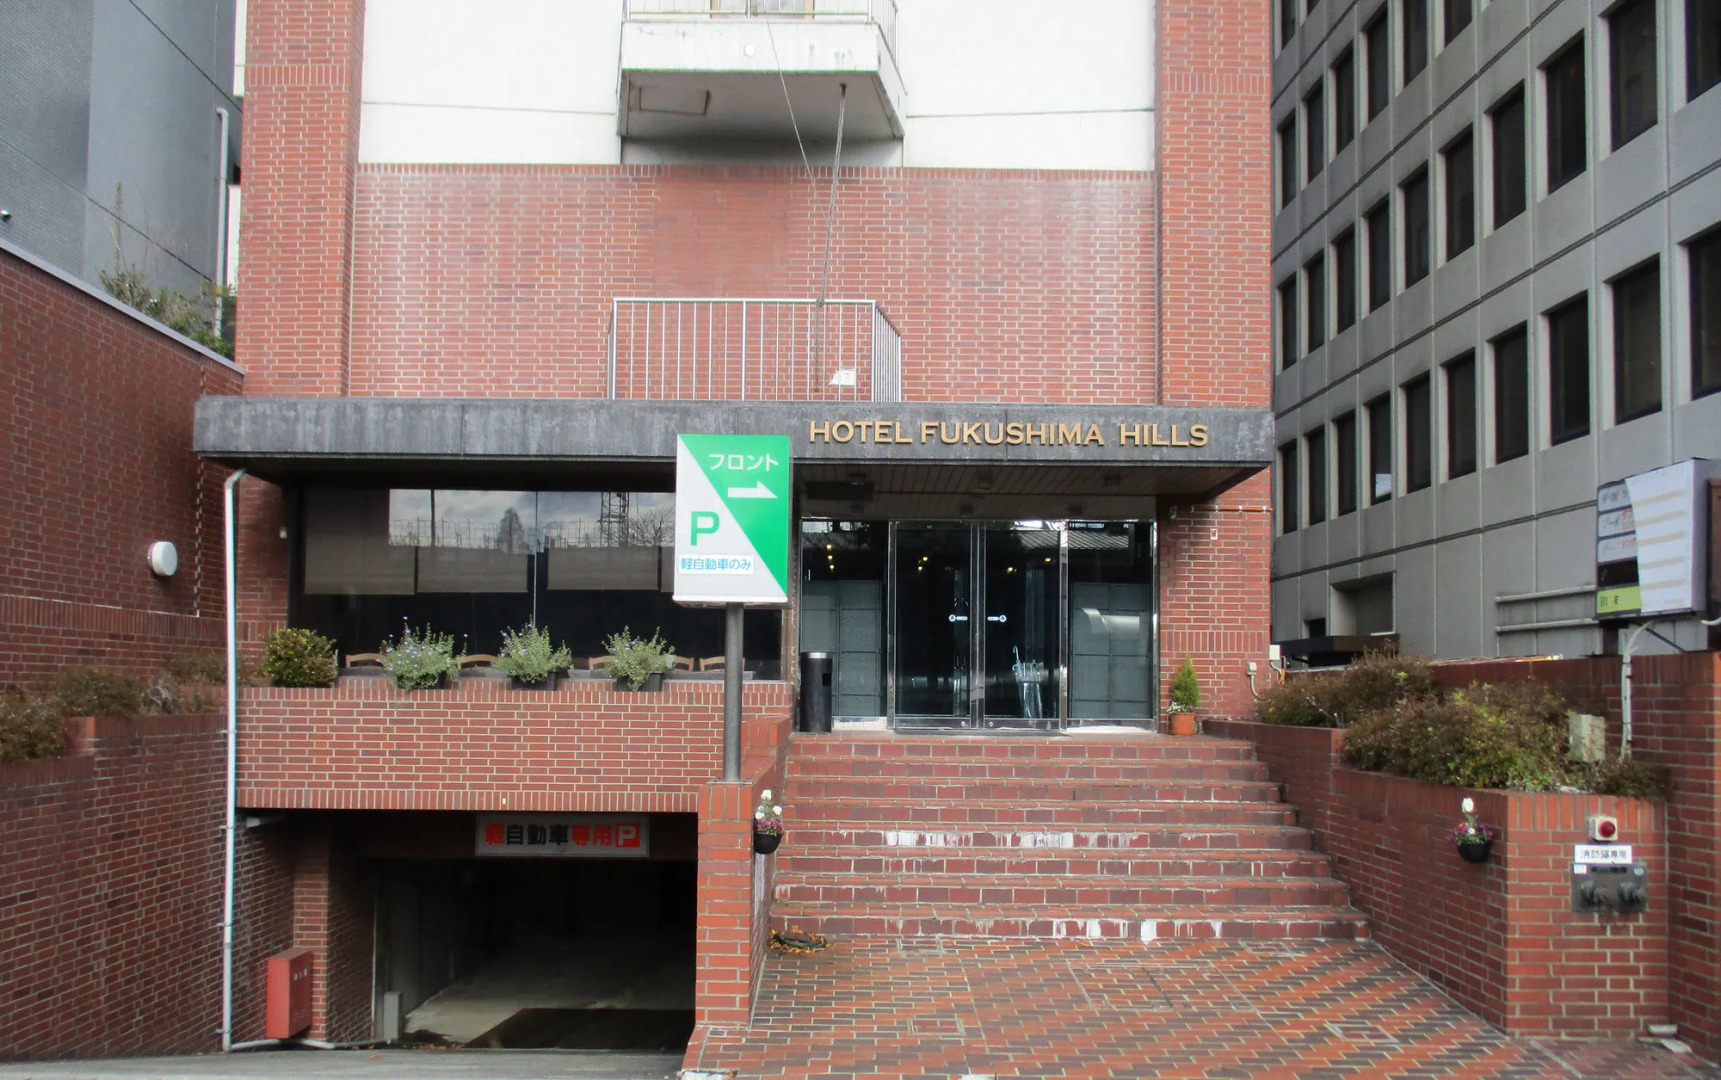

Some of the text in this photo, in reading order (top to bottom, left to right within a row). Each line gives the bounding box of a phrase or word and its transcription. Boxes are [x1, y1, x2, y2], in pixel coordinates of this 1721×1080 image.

[810, 420, 1209, 447] HOTEL FUKUSHIMA HILLS
[708, 453, 779, 472] フロント
[690, 511, 720, 546] P
[681, 558, 752, 571] 軽自動車のみ
